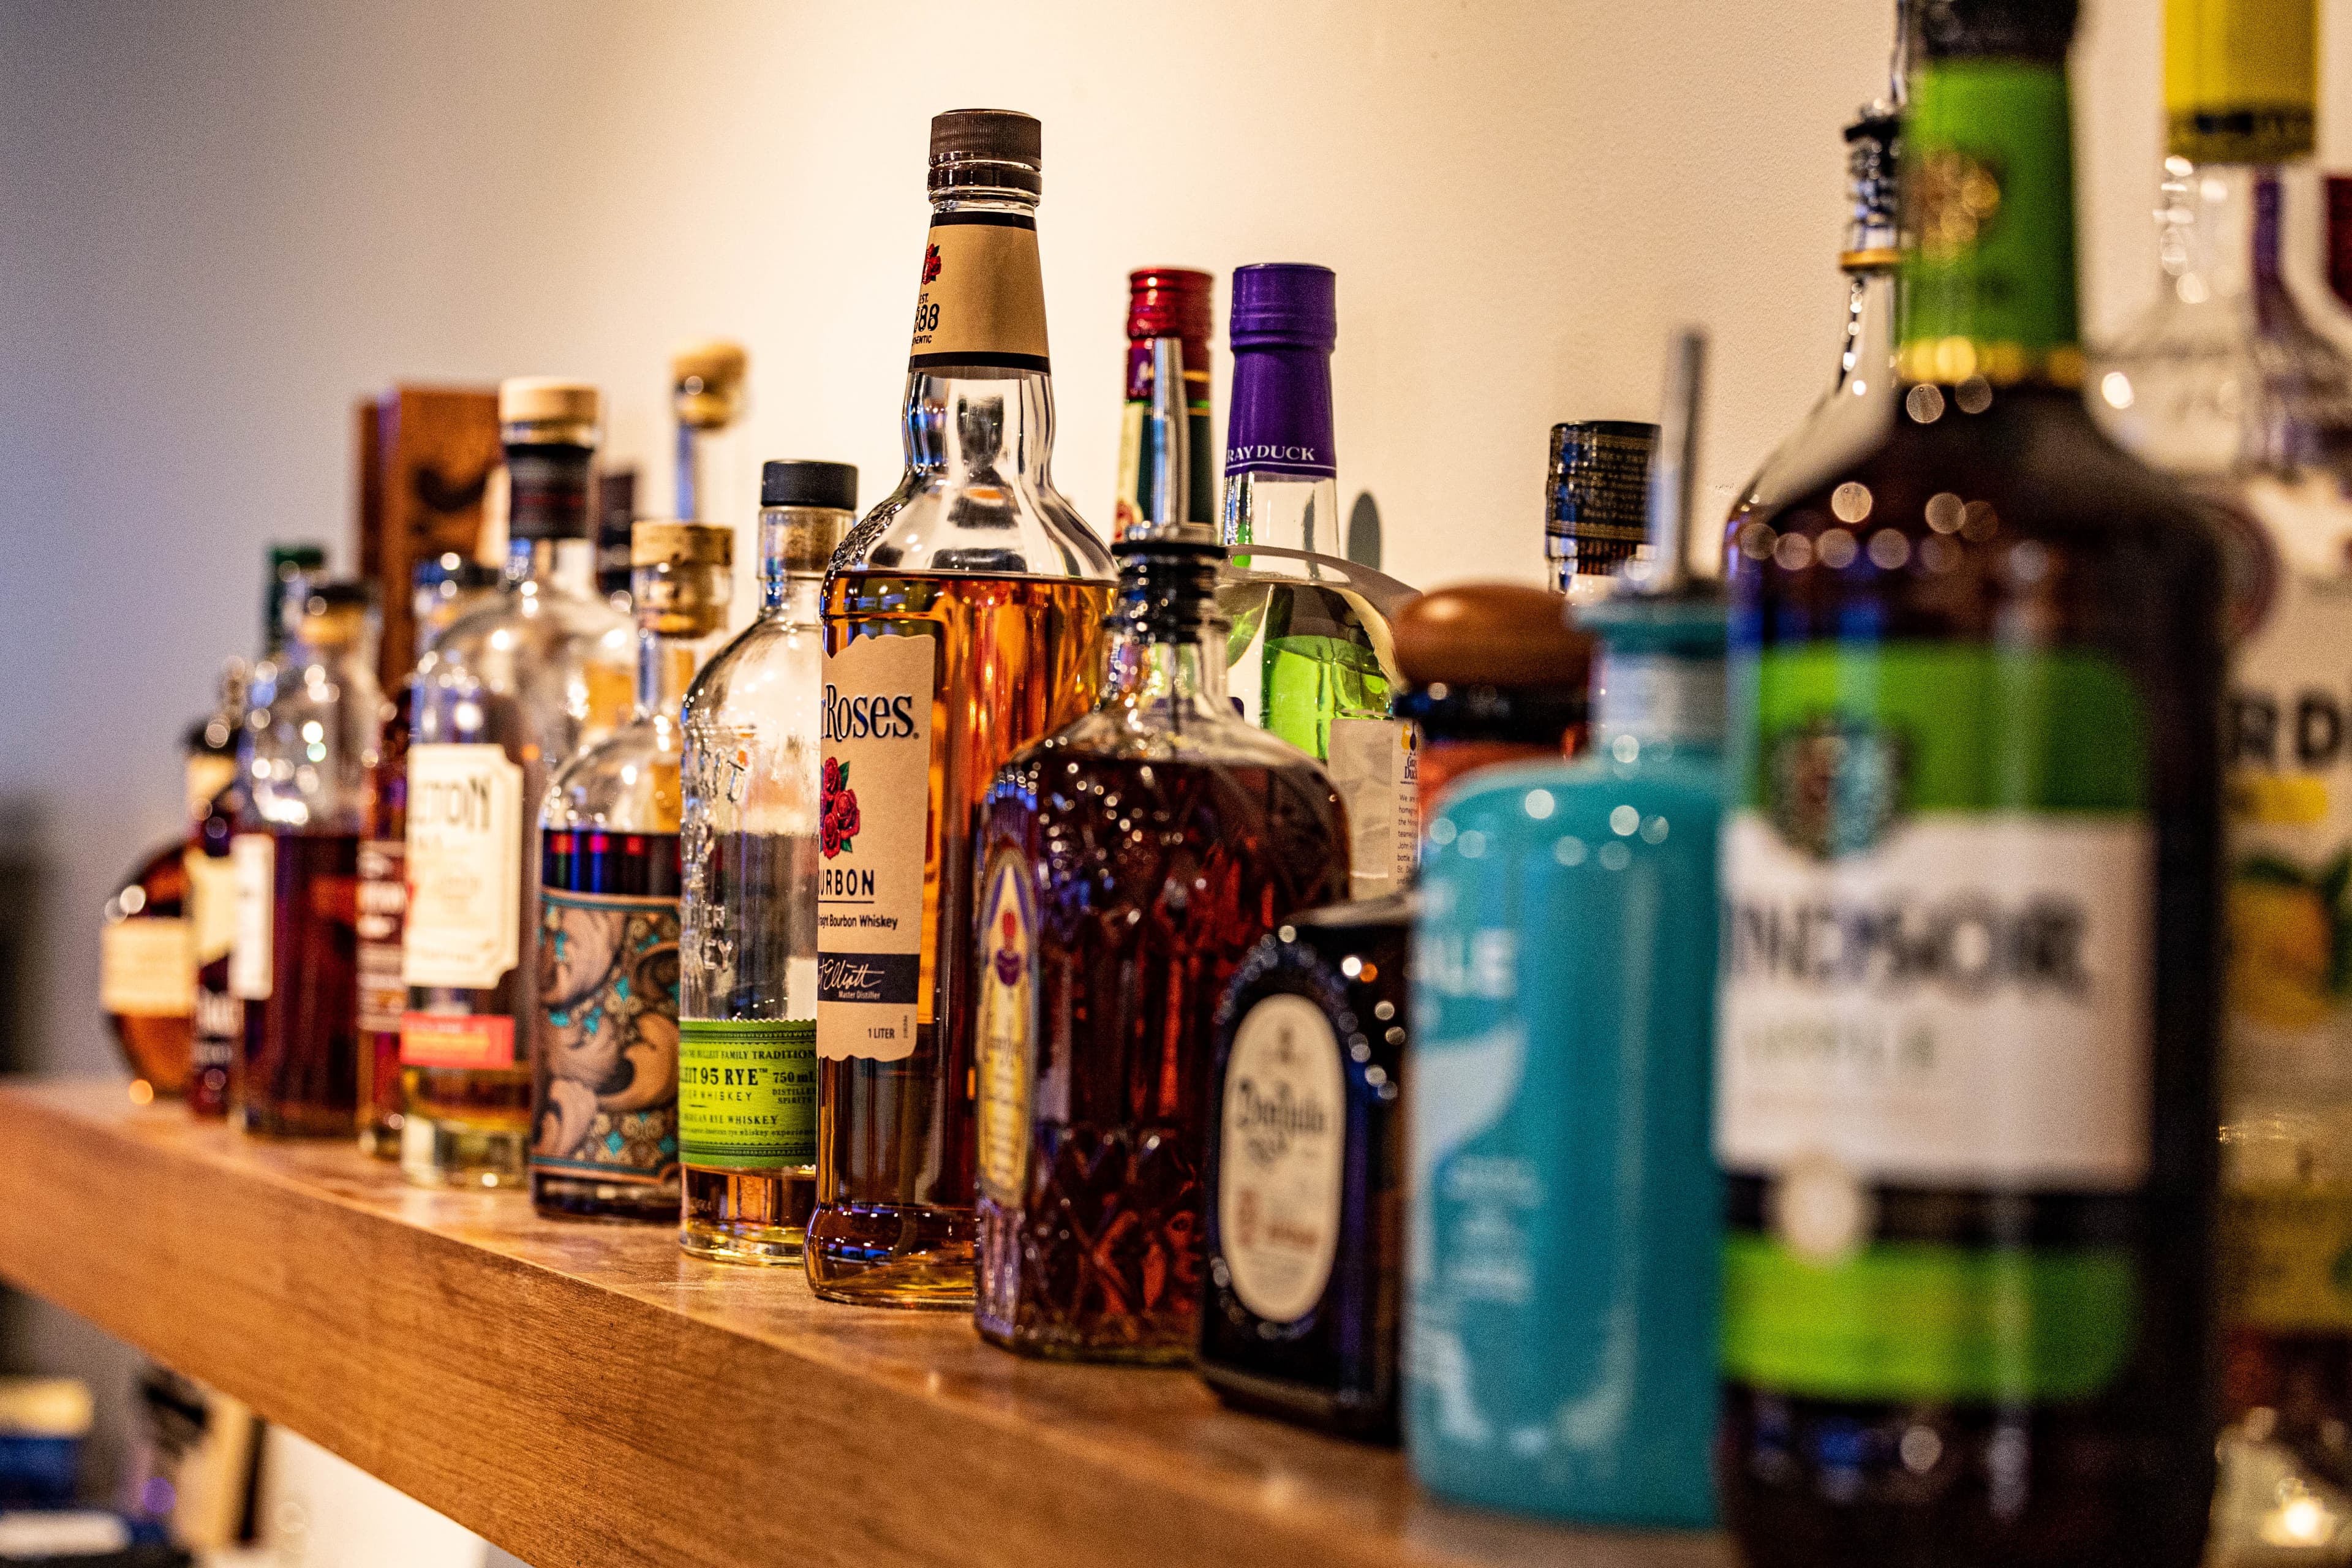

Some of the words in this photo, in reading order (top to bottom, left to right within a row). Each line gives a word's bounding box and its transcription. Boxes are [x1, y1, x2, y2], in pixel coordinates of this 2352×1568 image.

[1257, 445, 1315, 461] DUCK
[818, 869, 874, 895] URBON
[829, 914, 857, 927] Bourbon
[859, 914, 898, 930] Whiskey
[838, 990, 855, 999] Master
[856, 990, 881, 1000] Distiller
[868, 1028, 872, 1038] 1
[873, 1028, 895, 1039] LITER
[721, 1051, 748, 1060] FAMILY
[752, 1050, 816, 1059] TRADITION
[701, 1068, 718, 1085] 95
[772, 1071, 794, 1084] 750
[797, 1071, 817, 1083] mL
[701, 1091, 753, 1102] WHISKEY
[728, 1115, 778, 1125] WHISKEY
